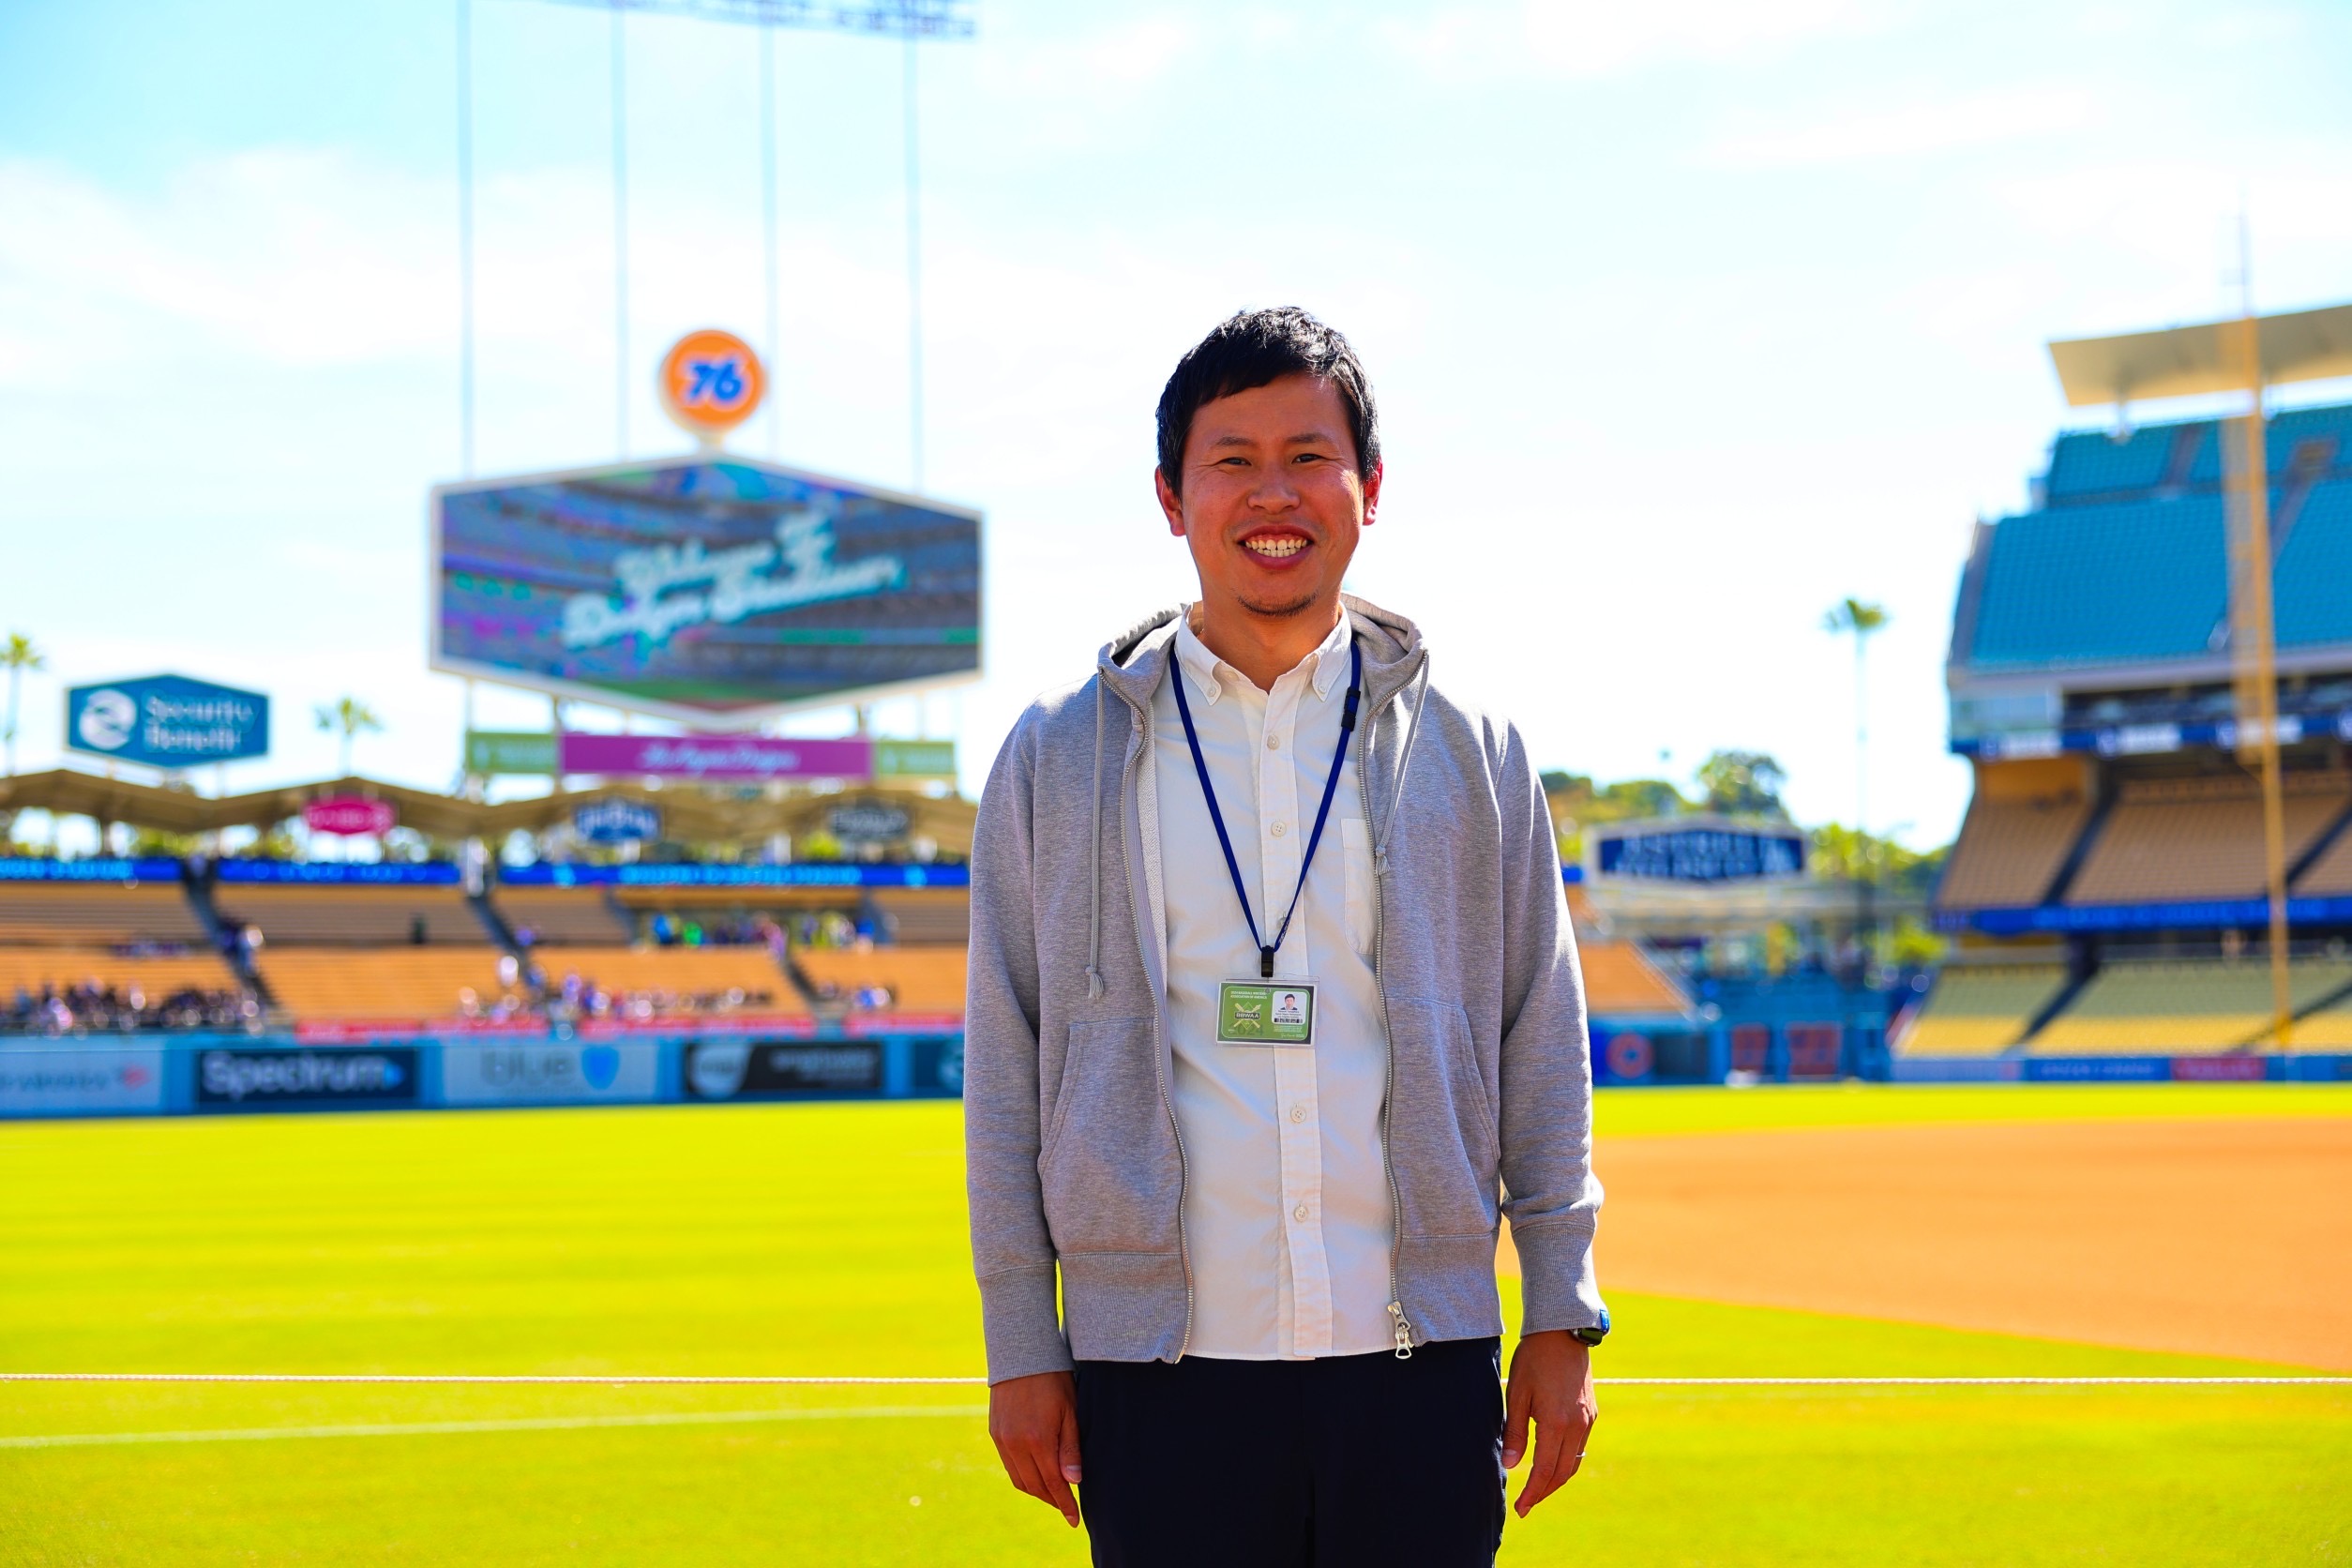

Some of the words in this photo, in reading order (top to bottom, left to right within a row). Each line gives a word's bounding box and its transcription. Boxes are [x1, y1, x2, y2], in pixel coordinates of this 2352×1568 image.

[687, 358, 745, 403] 76
[202, 1049, 386, 1102] Spectrum
[479, 1043, 576, 1088] blue
